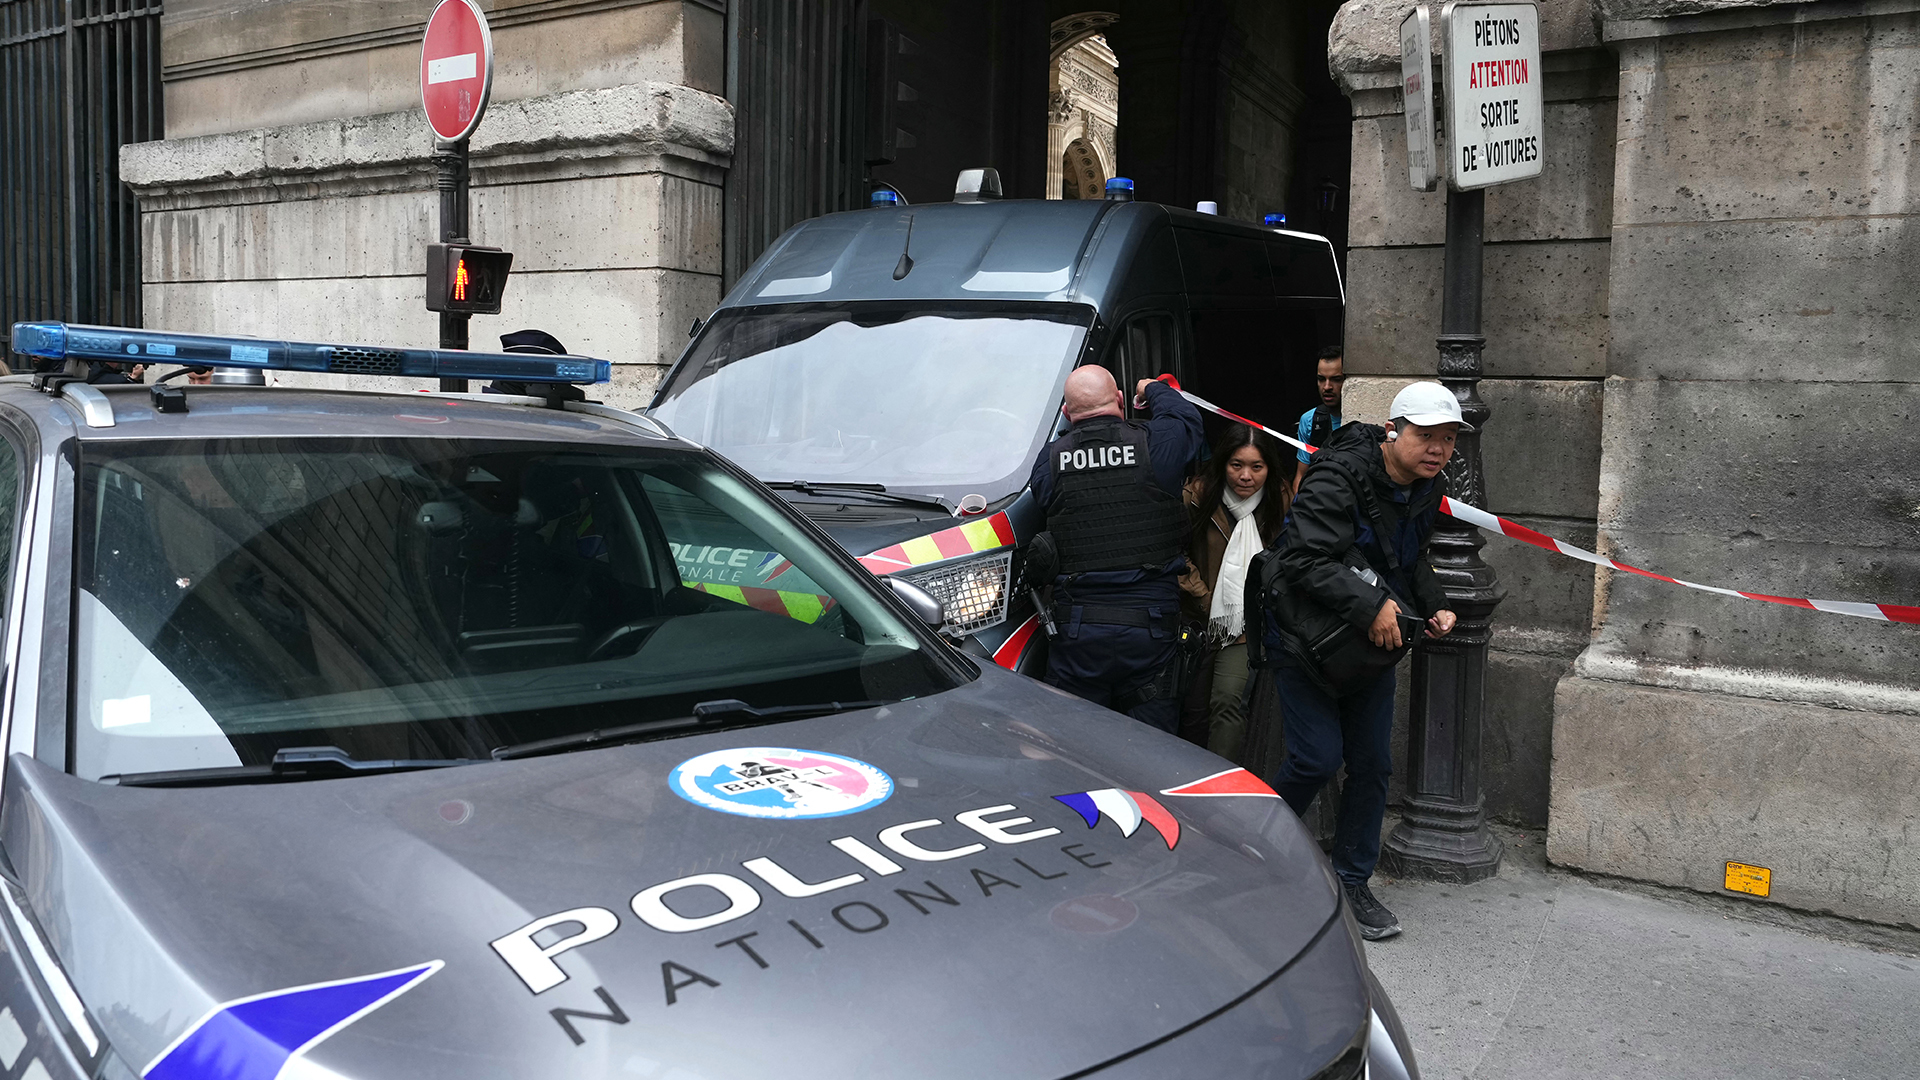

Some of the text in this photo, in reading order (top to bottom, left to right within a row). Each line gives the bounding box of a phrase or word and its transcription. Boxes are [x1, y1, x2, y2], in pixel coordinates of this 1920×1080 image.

[1475, 13, 1520, 47] PIÉTONS
[1469, 58, 1529, 89] ATTENTION
[1480, 99, 1519, 129] SORTIE
[1463, 136, 1538, 173] DE VOITURES
[1060, 445, 1136, 471] POLICE
[668, 542, 754, 568] LICE
[677, 565, 743, 583] ONALE
[487, 802, 1064, 996] POLICE
[548, 843, 1113, 1047] NATIONALE
